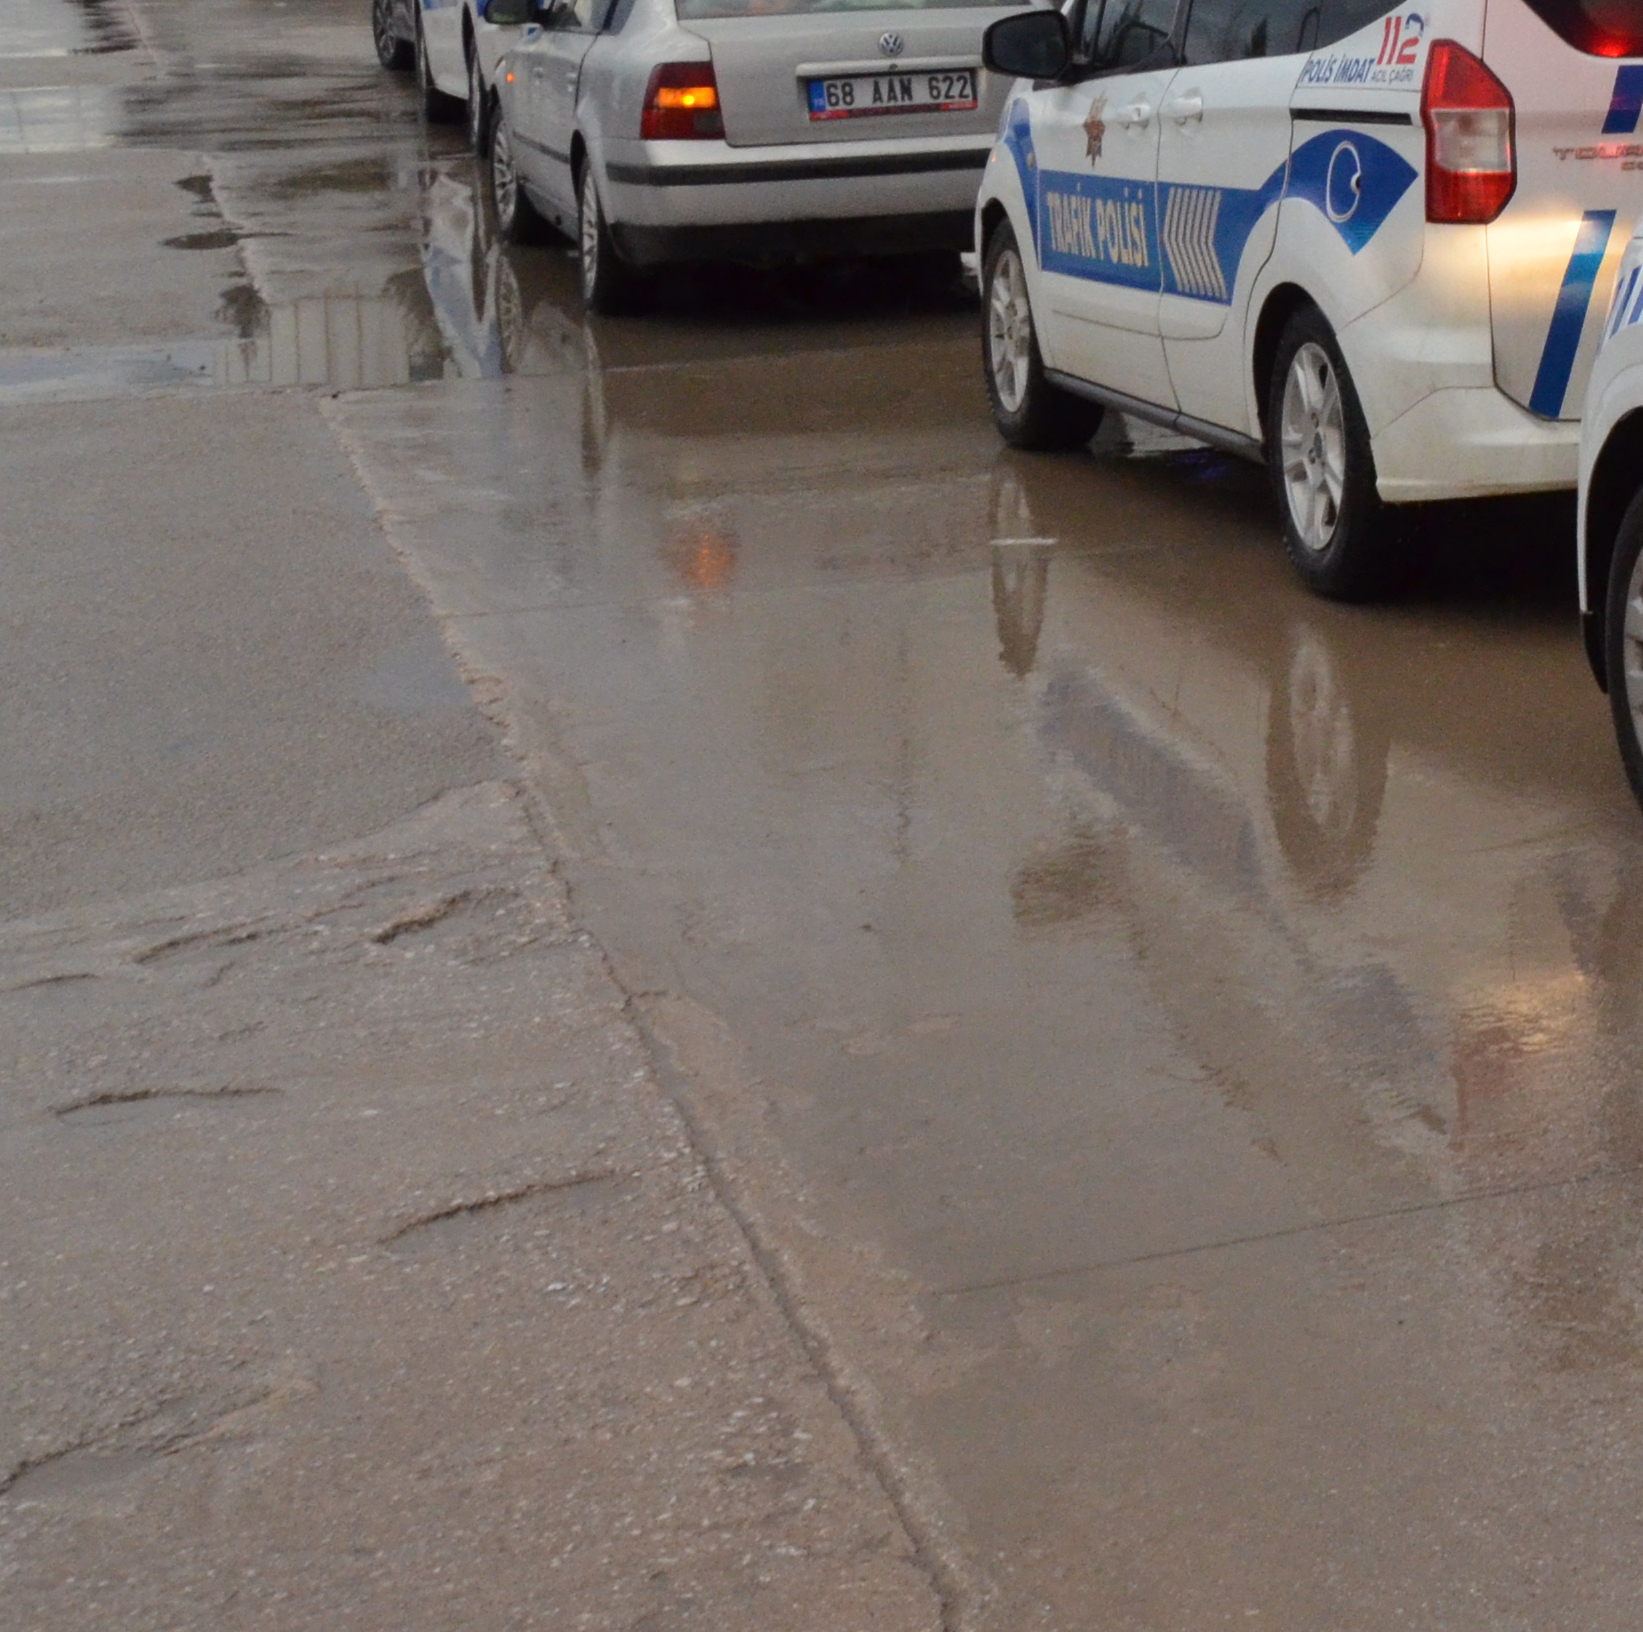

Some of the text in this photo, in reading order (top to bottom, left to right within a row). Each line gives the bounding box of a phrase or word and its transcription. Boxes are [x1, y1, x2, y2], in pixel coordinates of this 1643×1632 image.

[1376, 13, 1425, 66] 112
[1301, 54, 1377, 83] POLİS İMDAT
[825, 74, 971, 107] 68 AAN 622
[1095, 186, 1149, 268] POLİSİ
